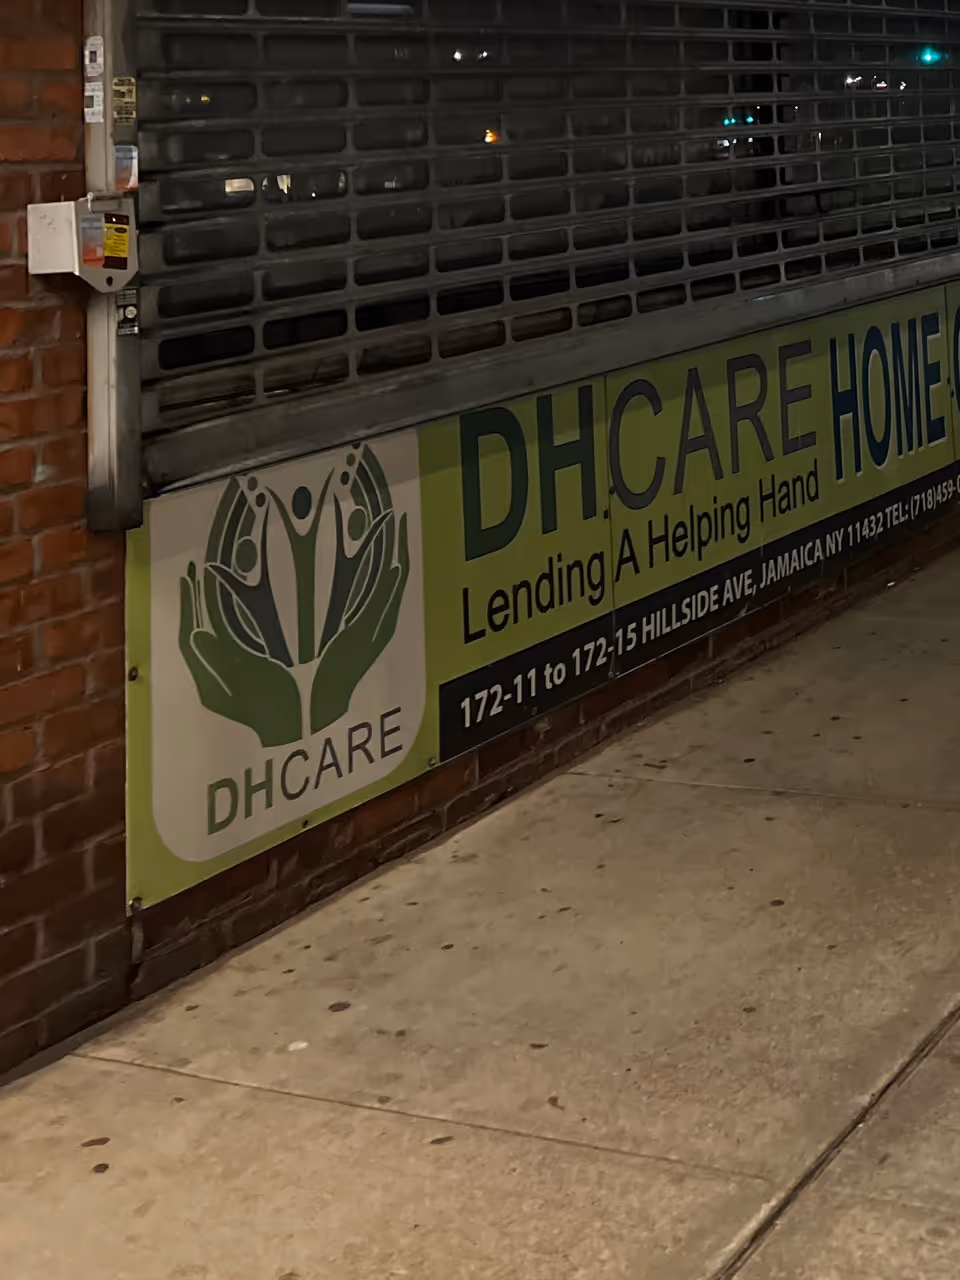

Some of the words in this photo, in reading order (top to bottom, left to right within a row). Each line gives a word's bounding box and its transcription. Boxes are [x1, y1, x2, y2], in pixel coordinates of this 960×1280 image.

[459, 341, 817, 562] DHCARE
[829, 311, 948, 483] HOME
[460, 667, 538, 728] 172-11
[544, 662, 567, 692] to
[571, 623, 638, 677] 172-15
[641, 587, 720, 645] HILLSIDE
[722, 568, 758, 607] AVE,
[759, 538, 824, 588] JAMAICA
[825, 527, 844, 556] NY
[847, 511, 884, 548] 11432
[884, 503, 909, 529] TEL:
[462, 551, 606, 645] Lending
[614, 528, 640, 583] A
[647, 494, 750, 569] Helping
[758, 458, 820, 523] Hand
[206, 707, 403, 836] DHCARE
